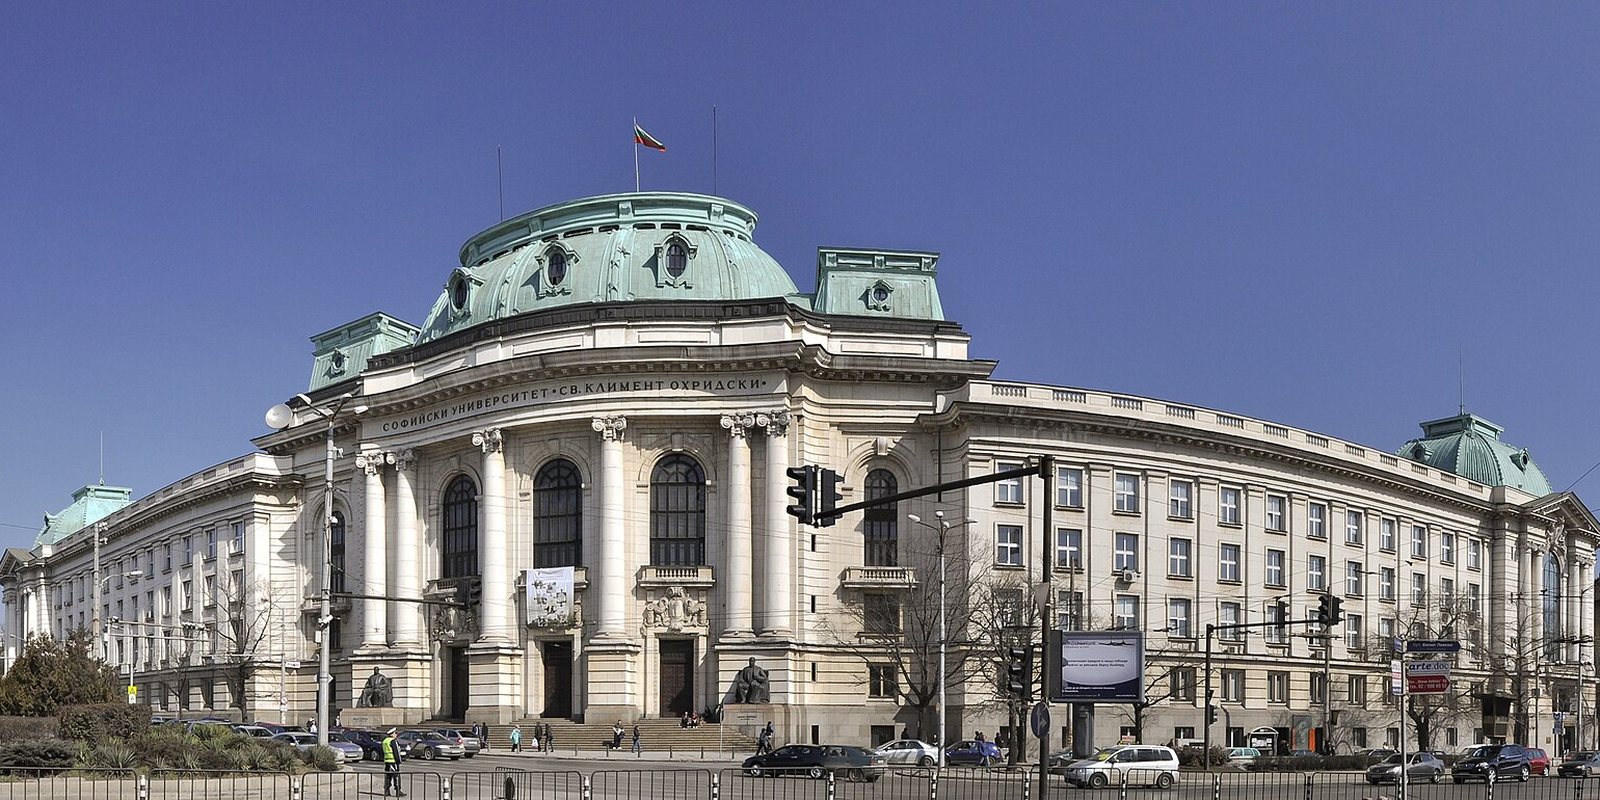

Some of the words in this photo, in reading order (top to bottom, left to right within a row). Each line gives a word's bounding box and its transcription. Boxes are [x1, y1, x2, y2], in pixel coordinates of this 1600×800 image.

[382, 409, 448, 431] СОФИЙСКИ
[452, 388, 548, 415] УНИВЕРСИТЕТ
[559, 386, 581, 395] СВ.
[585, 381, 664, 393] КЛИМЕНТ
[670, 380, 759, 391] ОХРИДСКИ
